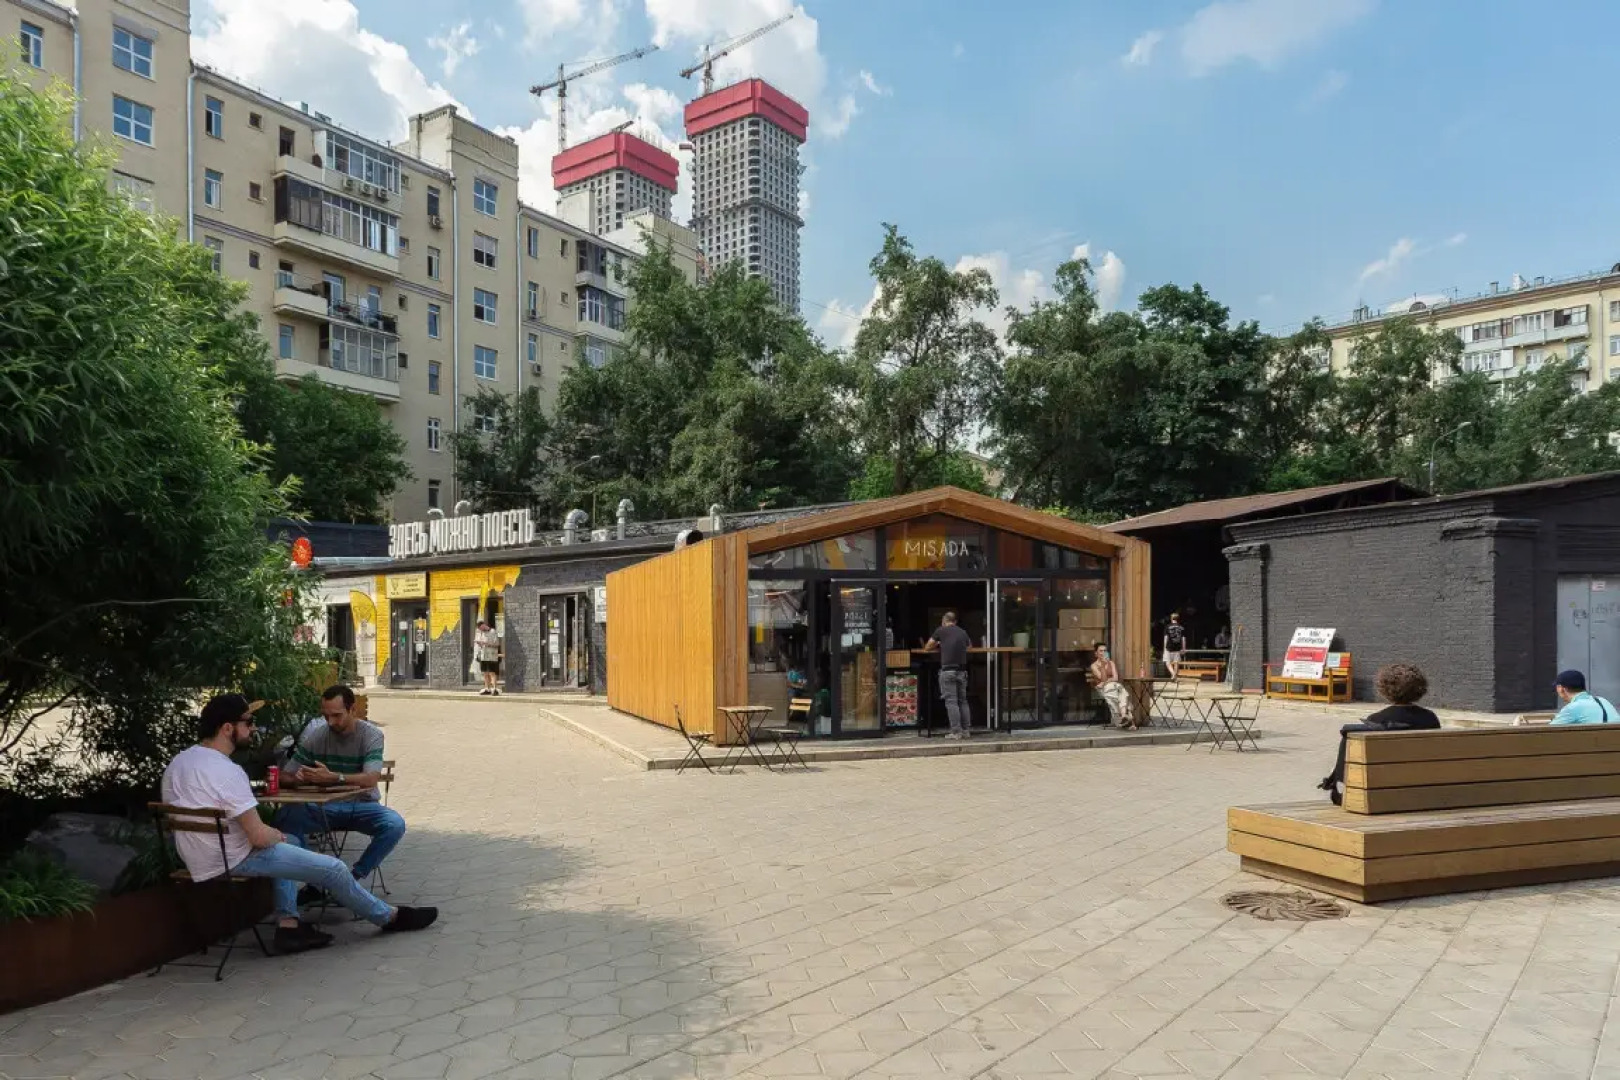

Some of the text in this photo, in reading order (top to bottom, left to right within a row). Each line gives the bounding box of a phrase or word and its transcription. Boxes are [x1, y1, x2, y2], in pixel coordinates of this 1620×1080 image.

[388, 508, 534, 559] ЗДЕСЬ МОЖНО ПОЕСТЬ
[905, 540, 969, 557] MISADA
